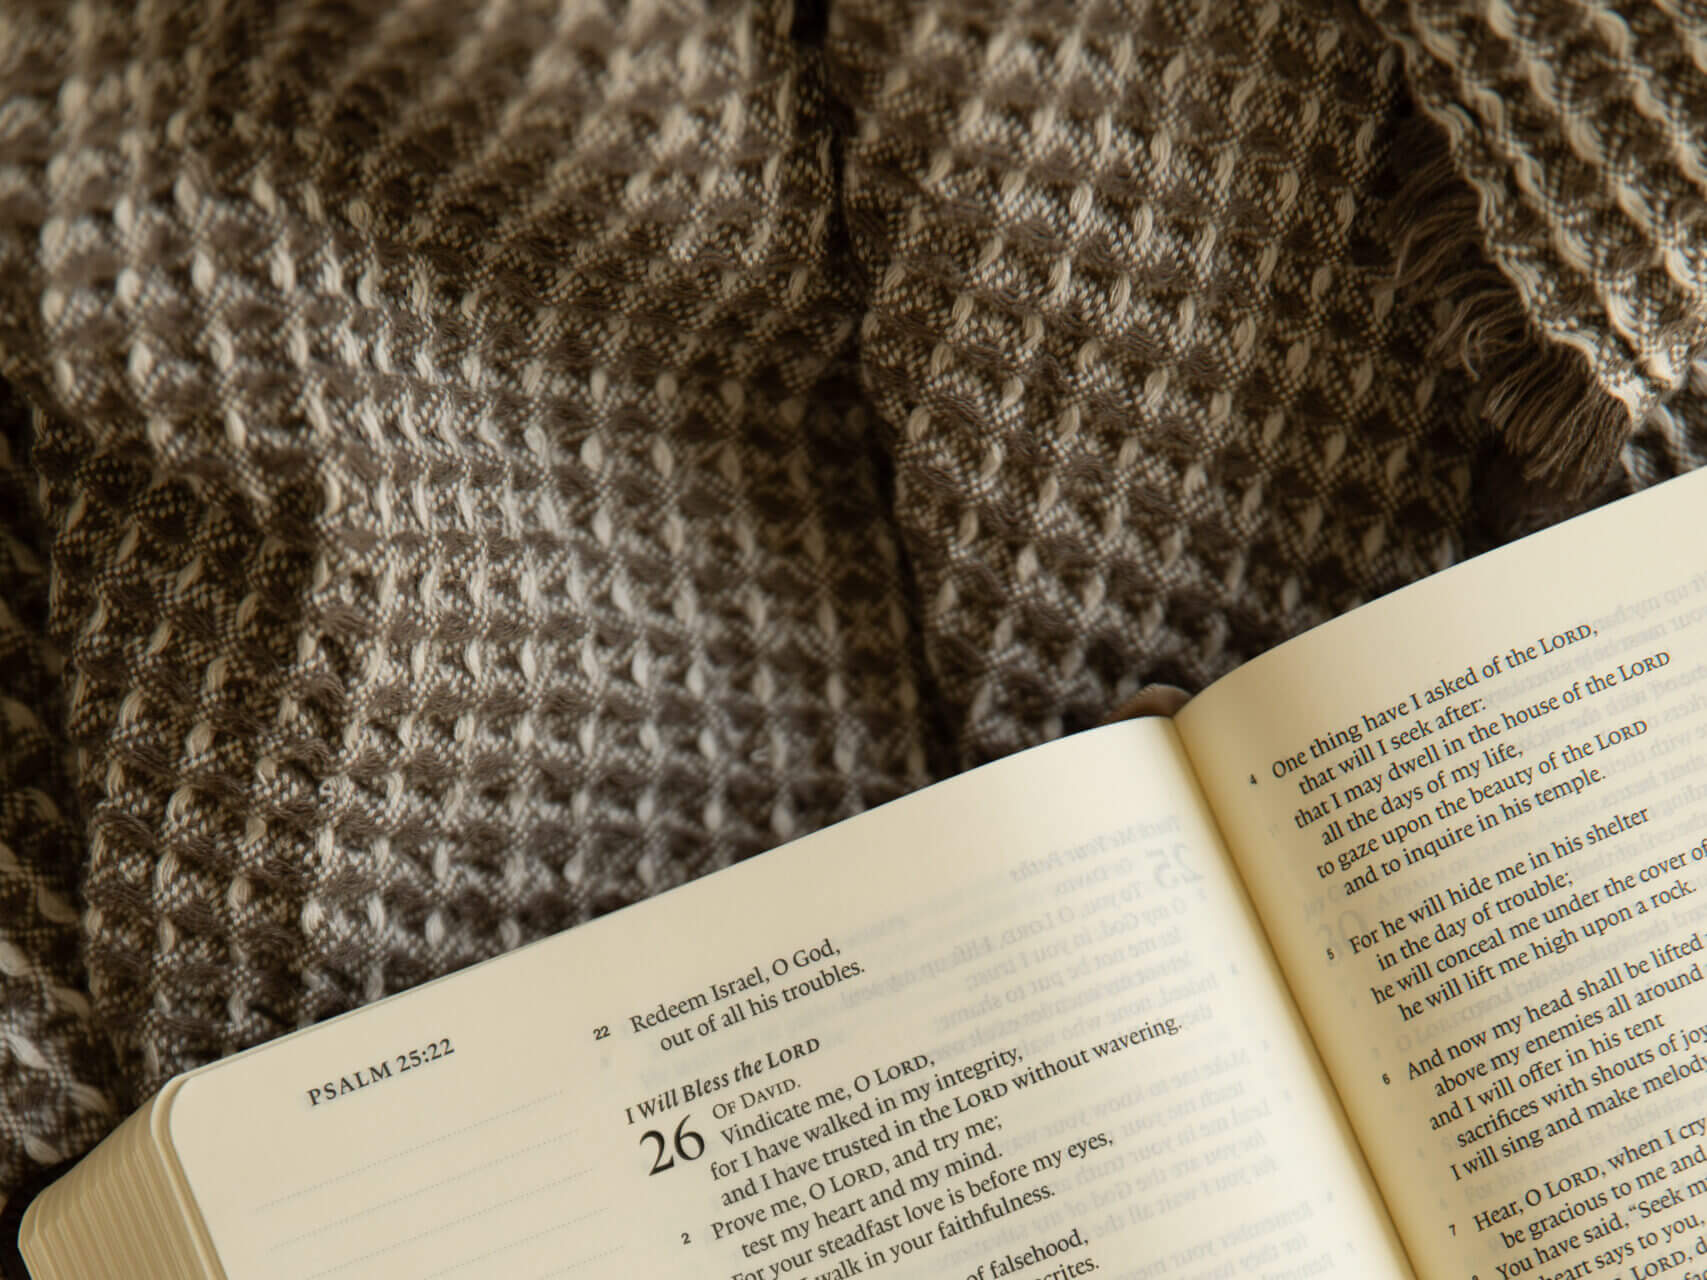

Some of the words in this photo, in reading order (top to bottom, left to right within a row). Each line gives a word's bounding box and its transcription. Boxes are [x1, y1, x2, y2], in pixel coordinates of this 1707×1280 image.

[1298, 767, 1337, 796] that
[1337, 743, 1377, 774] will
[1375, 738, 1389, 757] I
[1390, 719, 1434, 751] seek
[1435, 698, 1487, 730] after:
[1321, 820, 1345, 846] all
[1345, 808, 1379, 833] the
[1380, 786, 1424, 816] days
[1426, 769, 1448, 794] of
[1450, 759, 1480, 784] my
[1482, 743, 1524, 769] life,
[592, 1025, 611, 1041] 22
[629, 993, 710, 1033] Redeem
[709, 966, 770, 1002] Israel,
[771, 958, 789, 976] O
[792, 937, 841, 968] God,
[1397, 1000, 1425, 1022] he
[1424, 977, 1464, 1008] will
[1462, 964, 1497, 990] lift
[1497, 951, 1530, 976] me
[1528, 928, 1580, 960] high
[1580, 907, 1633, 938] upon
[1635, 900, 1649, 915] a
[1649, 879, 1697, 909] rock.
[660, 1028, 695, 1052] out
[697, 1013, 718, 1037] of
[721, 1003, 747, 1028] all
[746, 993, 779, 1017] his
[781, 961, 865, 1003] troubles.
[307, 1061, 393, 1107] PSALM
[396, 1038, 455, 1073] 25:22
[625, 1107, 635, 1125] I
[636, 1088, 680, 1119] Will
[681, 1072, 730, 1103] Bless
[733, 1059, 763, 1083] the
[765, 1038, 820, 1070] LORD
[712, 1100, 736, 1120] OF
[739, 1078, 801, 1110] DAVID.
[719, 1100, 813, 1145] Vindicate
[814, 1087, 852, 1110] me,
[853, 1074, 871, 1093] O
[873, 1054, 935, 1086] LORD,
[721, 1177, 760, 1207] and
[759, 1173, 772, 1191] I
[772, 1157, 821, 1186] have
[821, 1124, 893, 1166] trusted
[893, 1119, 917, 1137] in
[918, 1104, 953, 1128] the
[952, 1082, 1009, 1114] LORD
[1011, 1050, 1090, 1090] without
[1091, 1018, 1182, 1058] wavering.
[1429, 1100, 1465, 1131] and
[1463, 1095, 1477, 1113] I
[1476, 1076, 1516, 1106] will
[1518, 1057, 1563, 1088] offer
[1565, 1048, 1590, 1067] in
[1588, 1032, 1622, 1056] his
[1623, 1014, 1665, 1041] tent
[639, 1114, 706, 1175] 26
[680, 1232, 692, 1246] 2
[710, 1208, 768, 1241] Prove
[770, 1194, 807, 1217] me,
[808, 1182, 826, 1201] O
[828, 1162, 890, 1193] LORD,
[892, 1138, 931, 1169] and
[932, 1130, 959, 1152] try
[964, 1115, 1002, 1140] me;
[1472, 1200, 1524, 1233] Hear,
[1524, 1188, 1542, 1207] O
[1543, 1165, 1607, 1199] LORD,
[1607, 1138, 1664, 1170] when
[1663, 1128, 1676, 1146] I
[1679, 1117, 1706, 1140] cry
[863, 1251, 887, 1269] in
[888, 1230, 934, 1264] your
[937, 1185, 1056, 1241] faithfulness.
[989, 1228, 1089, 1280] falsehood,
[1594, 1242, 1635, 1270] says
[1637, 1232, 1659, 1250] to
[1661, 1214, 1705, 1244] you,
